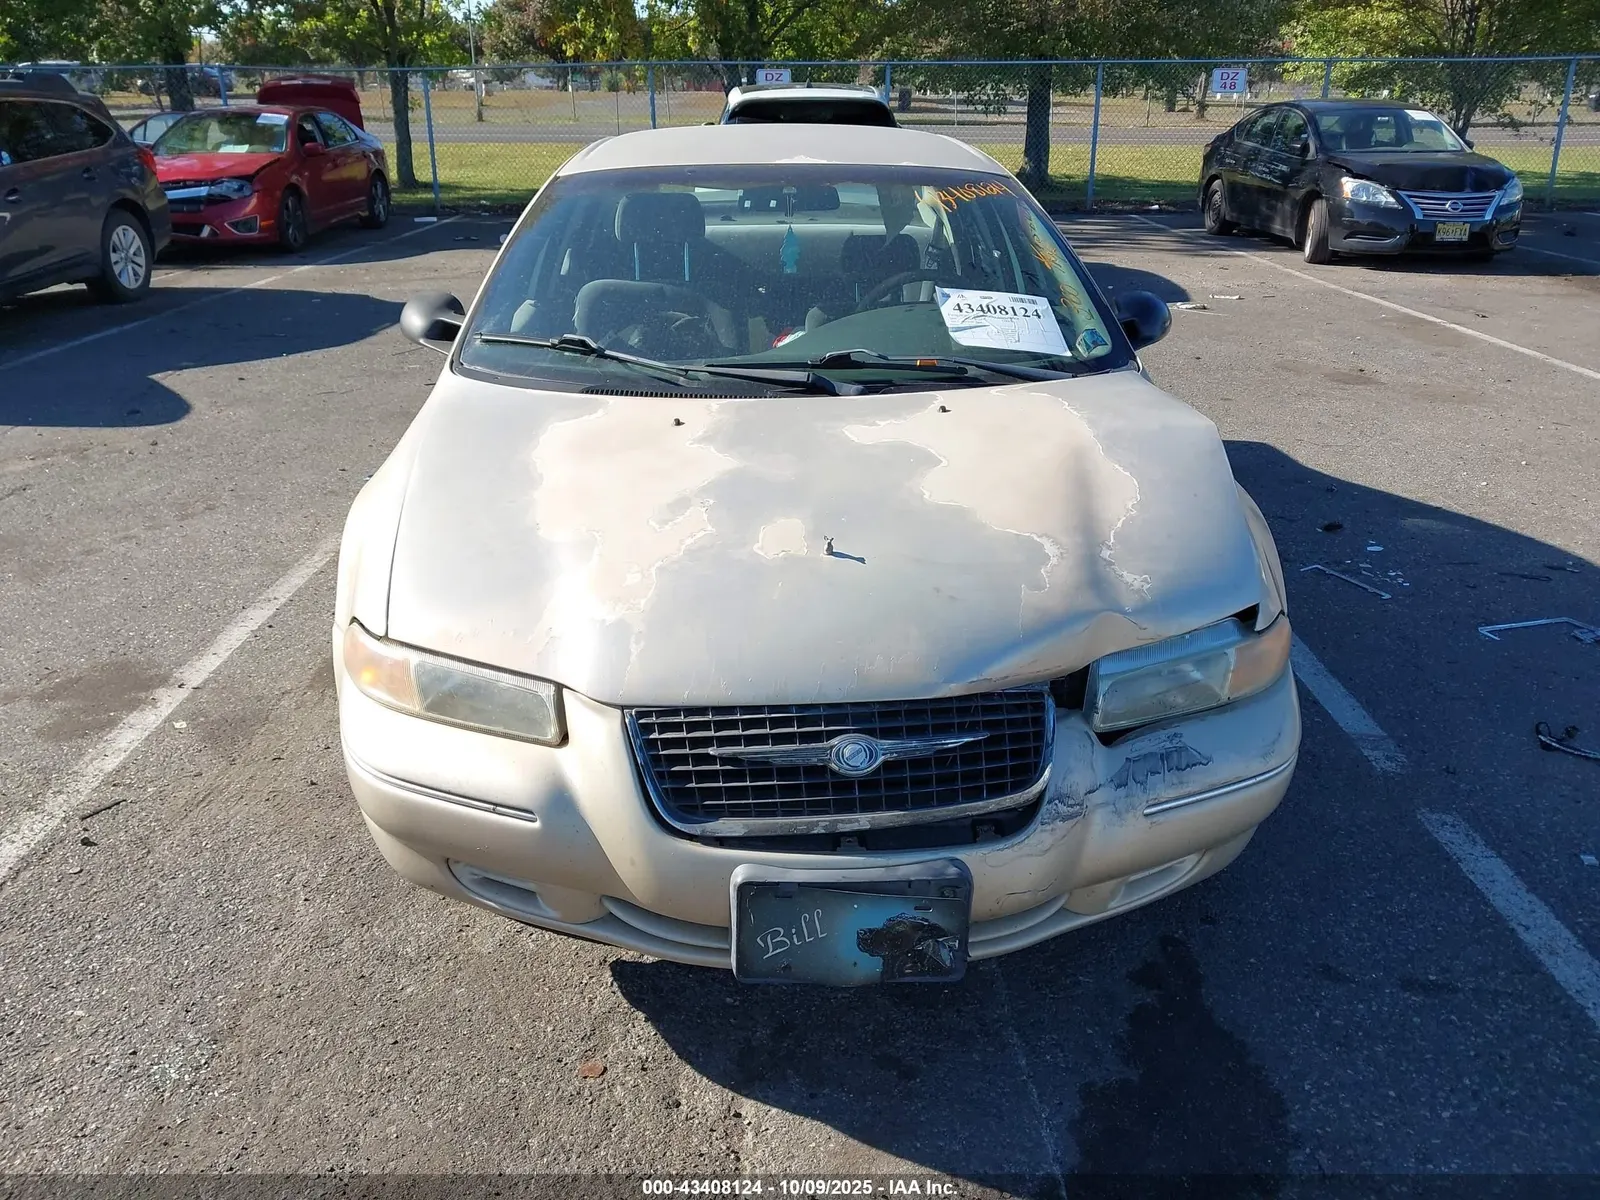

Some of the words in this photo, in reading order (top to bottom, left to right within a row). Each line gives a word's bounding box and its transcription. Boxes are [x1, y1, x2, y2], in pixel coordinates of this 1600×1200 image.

[765, 72, 784, 82] DZ
[1220, 71, 1240, 81] DZ
[1219, 81, 1237, 90] 48
[953, 302, 1042, 320] 43408124
[756, 908, 828, 960] Bill
